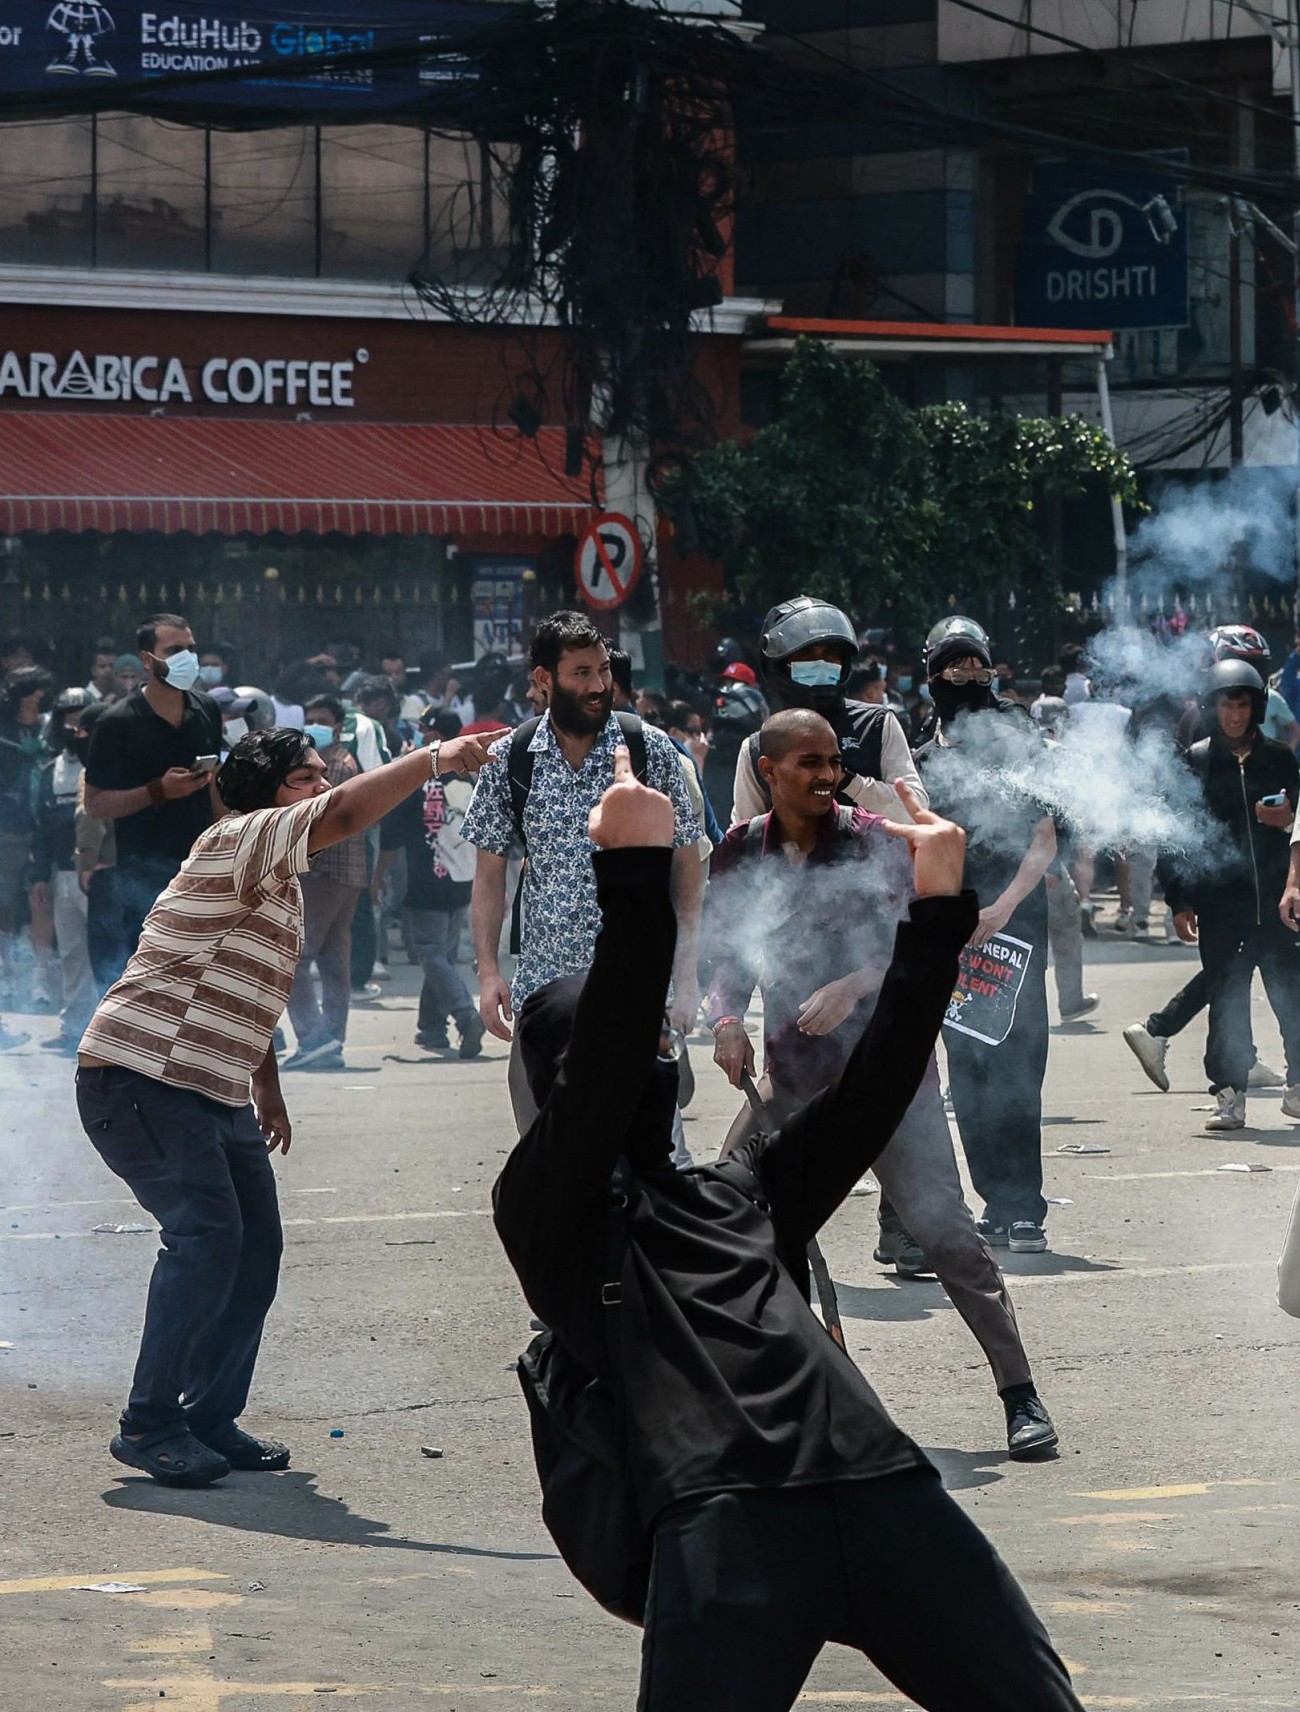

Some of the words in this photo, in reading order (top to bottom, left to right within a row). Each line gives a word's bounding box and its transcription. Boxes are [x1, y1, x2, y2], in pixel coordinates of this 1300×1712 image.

[141, 13, 262, 52] EduHub
[141, 52, 228, 72] EDUCATION
[1046, 265, 1157, 302] DRISHTI
[0, 350, 193, 402] ARABICA
[201, 357, 355, 407] COFFEE
[969, 953, 1014, 982] WON'T
[983, 942, 1023, 969] NEPAL
[957, 972, 998, 998] ILENT
